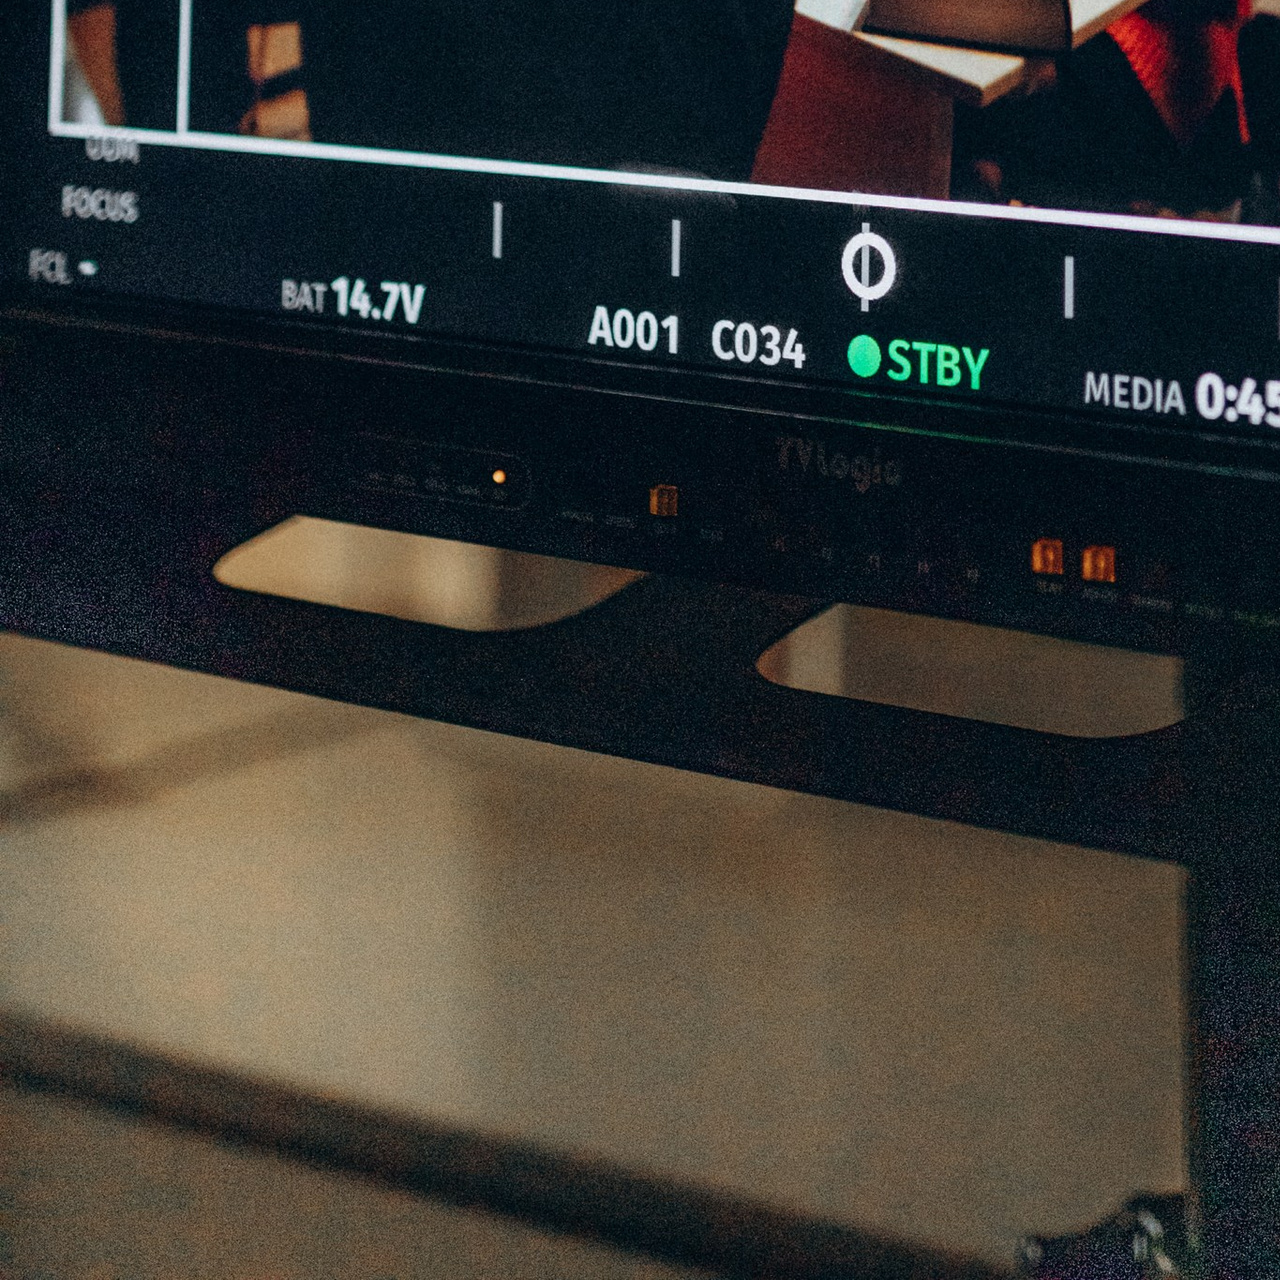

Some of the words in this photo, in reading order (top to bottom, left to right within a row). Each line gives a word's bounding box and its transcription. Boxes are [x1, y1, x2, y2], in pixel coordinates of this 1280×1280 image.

[61, 185, 139, 223] FOCUS
[281, 279, 327, 312] BAT
[331, 276, 426, 324] 14.7V
[588, 305, 678, 354] A001
[711, 319, 806, 369] C034
[887, 339, 990, 390] STBY
[1084, 371, 1186, 415] MEDIA
